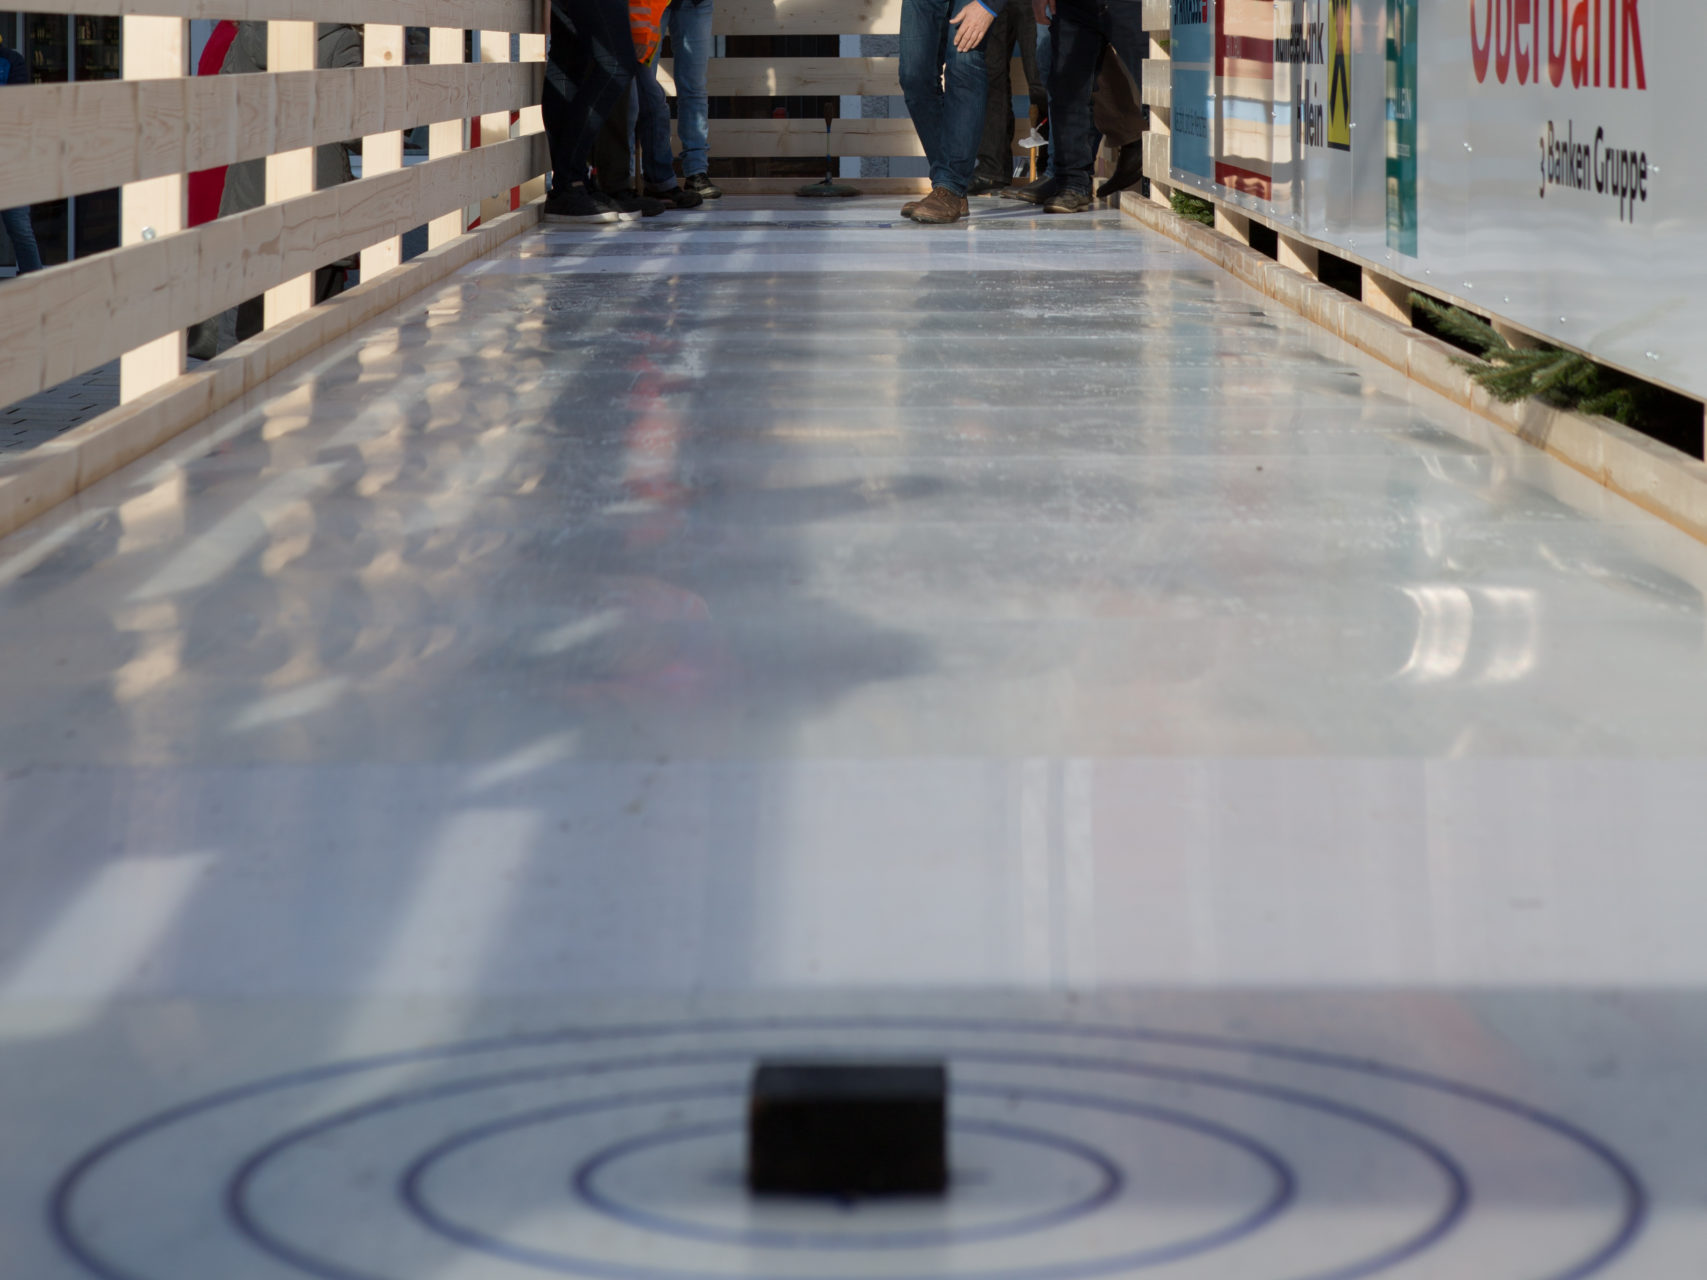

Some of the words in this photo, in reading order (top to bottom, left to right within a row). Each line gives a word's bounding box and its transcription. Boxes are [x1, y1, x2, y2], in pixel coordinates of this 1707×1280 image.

[1539, 137, 1545, 199] 3
[1548, 119, 1591, 191] Banken
[1594, 125, 1647, 224] Gruppe
